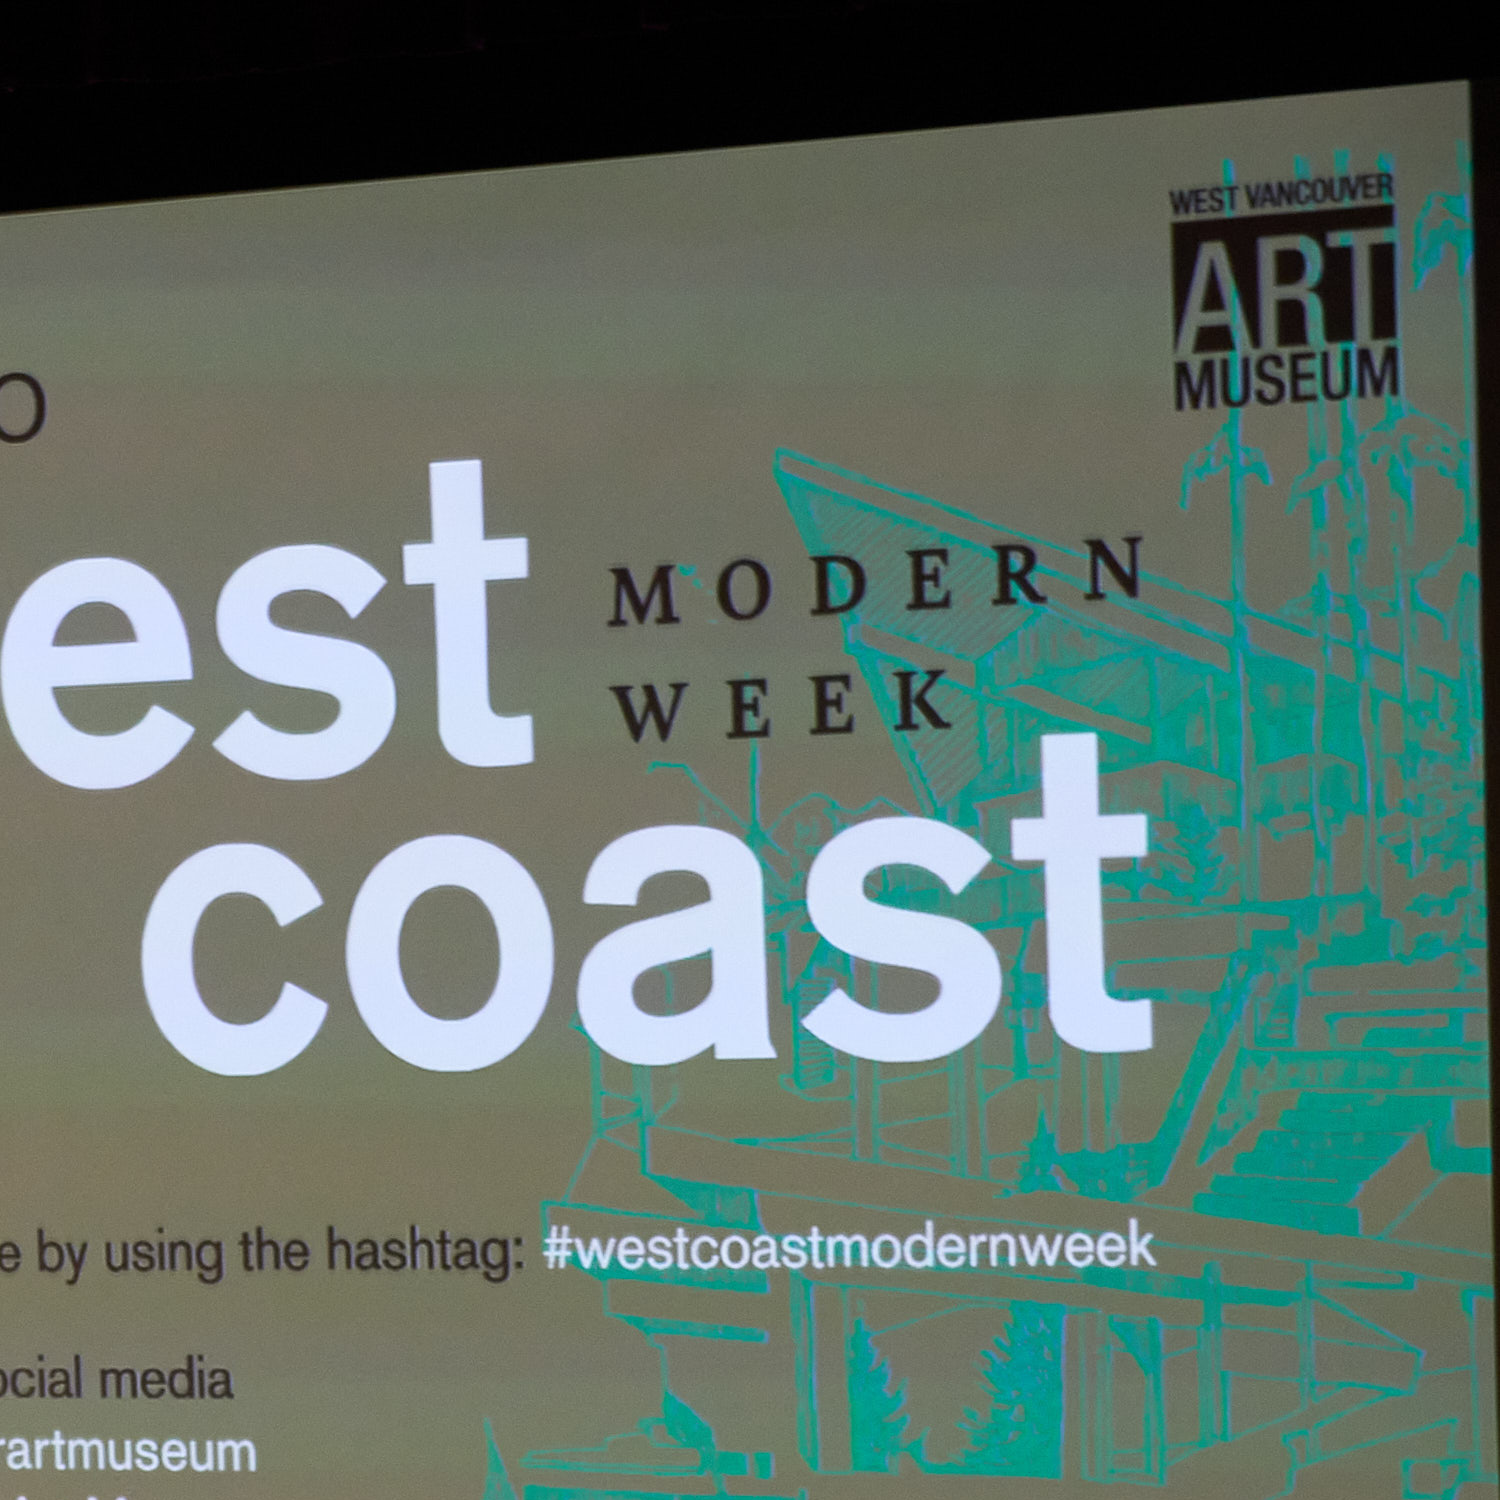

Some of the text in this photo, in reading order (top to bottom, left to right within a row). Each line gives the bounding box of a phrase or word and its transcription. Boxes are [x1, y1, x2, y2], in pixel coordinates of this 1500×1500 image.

[1169, 172, 1394, 215] WEST VANCOUVER
[1176, 226, 1397, 355] ART
[1174, 348, 1399, 411] MUSEUM
[607, 536, 1143, 628] MODERN
[610, 669, 953, 744] WEEK
[142, 733, 1154, 1077] coast
[37, 1228, 88, 1286] by
[106, 1228, 224, 1285] using
[241, 1227, 311, 1272] the
[327, 1226, 525, 1284] hashtag:
[542, 1220, 1158, 1270] #westcoastmodernweek
[99, 1355, 235, 1401] media
